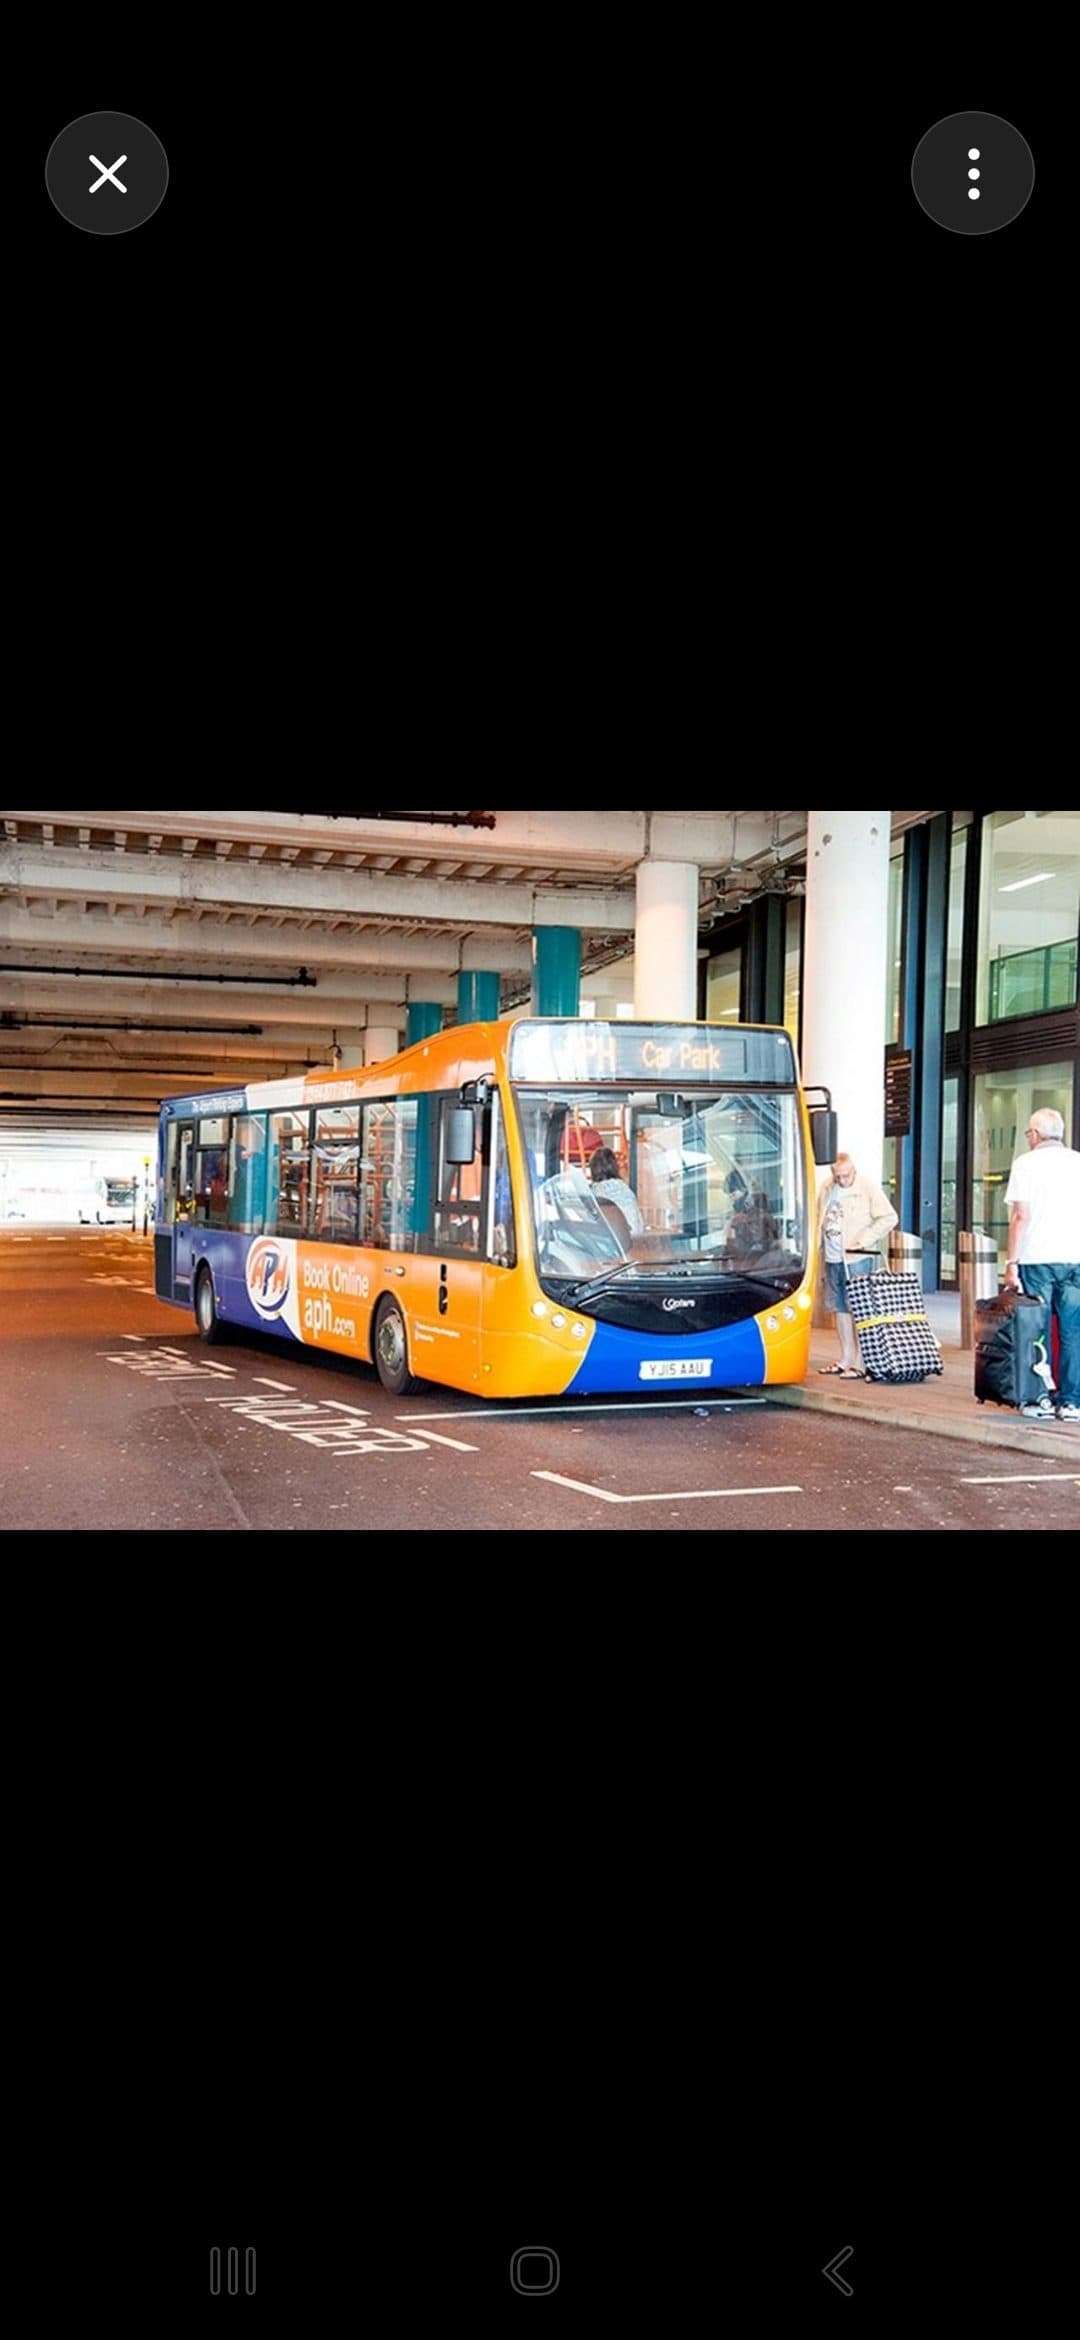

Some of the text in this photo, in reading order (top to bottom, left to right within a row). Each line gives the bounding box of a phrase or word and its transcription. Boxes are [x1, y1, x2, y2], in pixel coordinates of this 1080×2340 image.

[641, 1040, 671, 1068] Car
[680, 1042, 721, 1070] Park
[303, 1259, 369, 1299] Book Online
[304, 1291, 356, 1340] aph.com
[648, 1361, 705, 1377] YJ15 AAU
[204, 1392, 431, 1456] HOLDER
